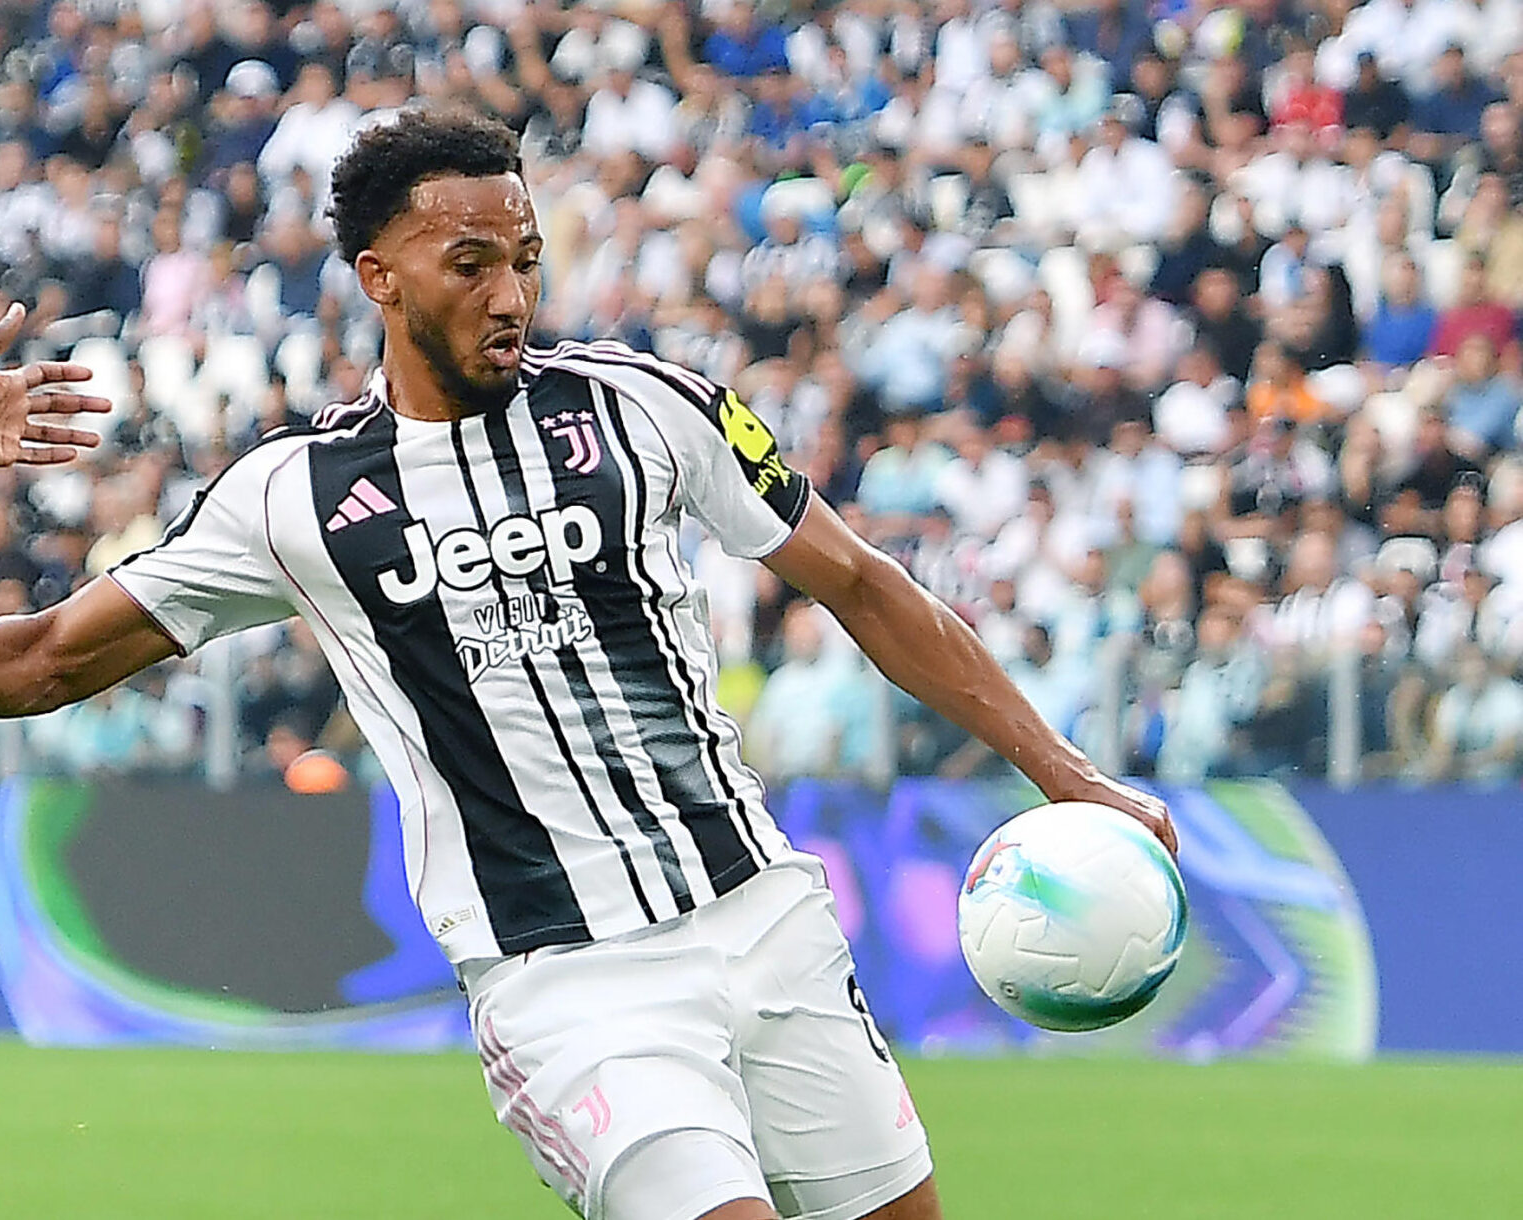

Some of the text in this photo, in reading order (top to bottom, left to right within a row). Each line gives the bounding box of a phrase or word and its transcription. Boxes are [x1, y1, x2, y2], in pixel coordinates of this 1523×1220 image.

[377, 504, 602, 603] Jeep
[456, 606, 591, 684] Detroit
[474, 592, 547, 634] VISIT
